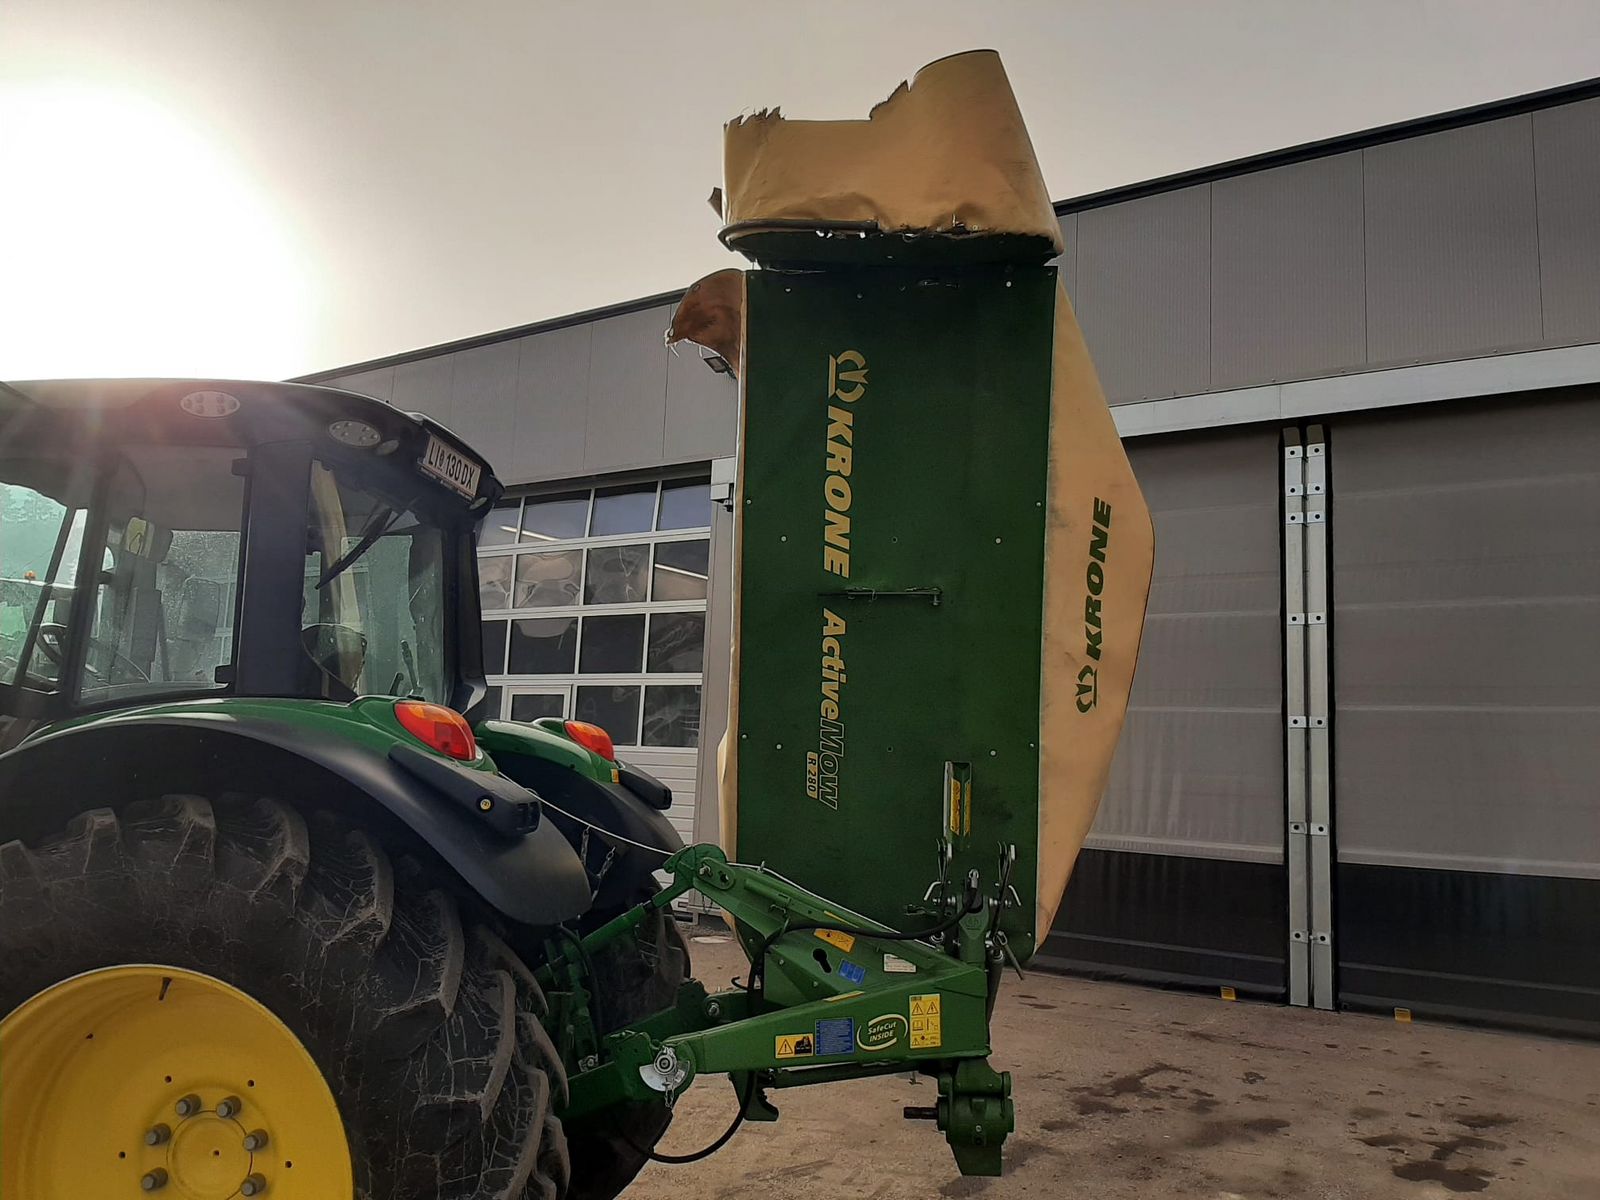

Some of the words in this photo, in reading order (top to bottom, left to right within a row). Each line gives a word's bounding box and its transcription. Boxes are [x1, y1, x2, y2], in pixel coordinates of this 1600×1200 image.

[824, 405, 853, 578] KRONE
[1085, 497, 1112, 661] KRONE
[820, 608, 846, 810] ActiveMow
[808, 757, 816, 766] R
[808, 770, 816, 792] 280
[867, 1021, 897, 1034] SafeCut
[869, 1031, 895, 1042] INSIDE
